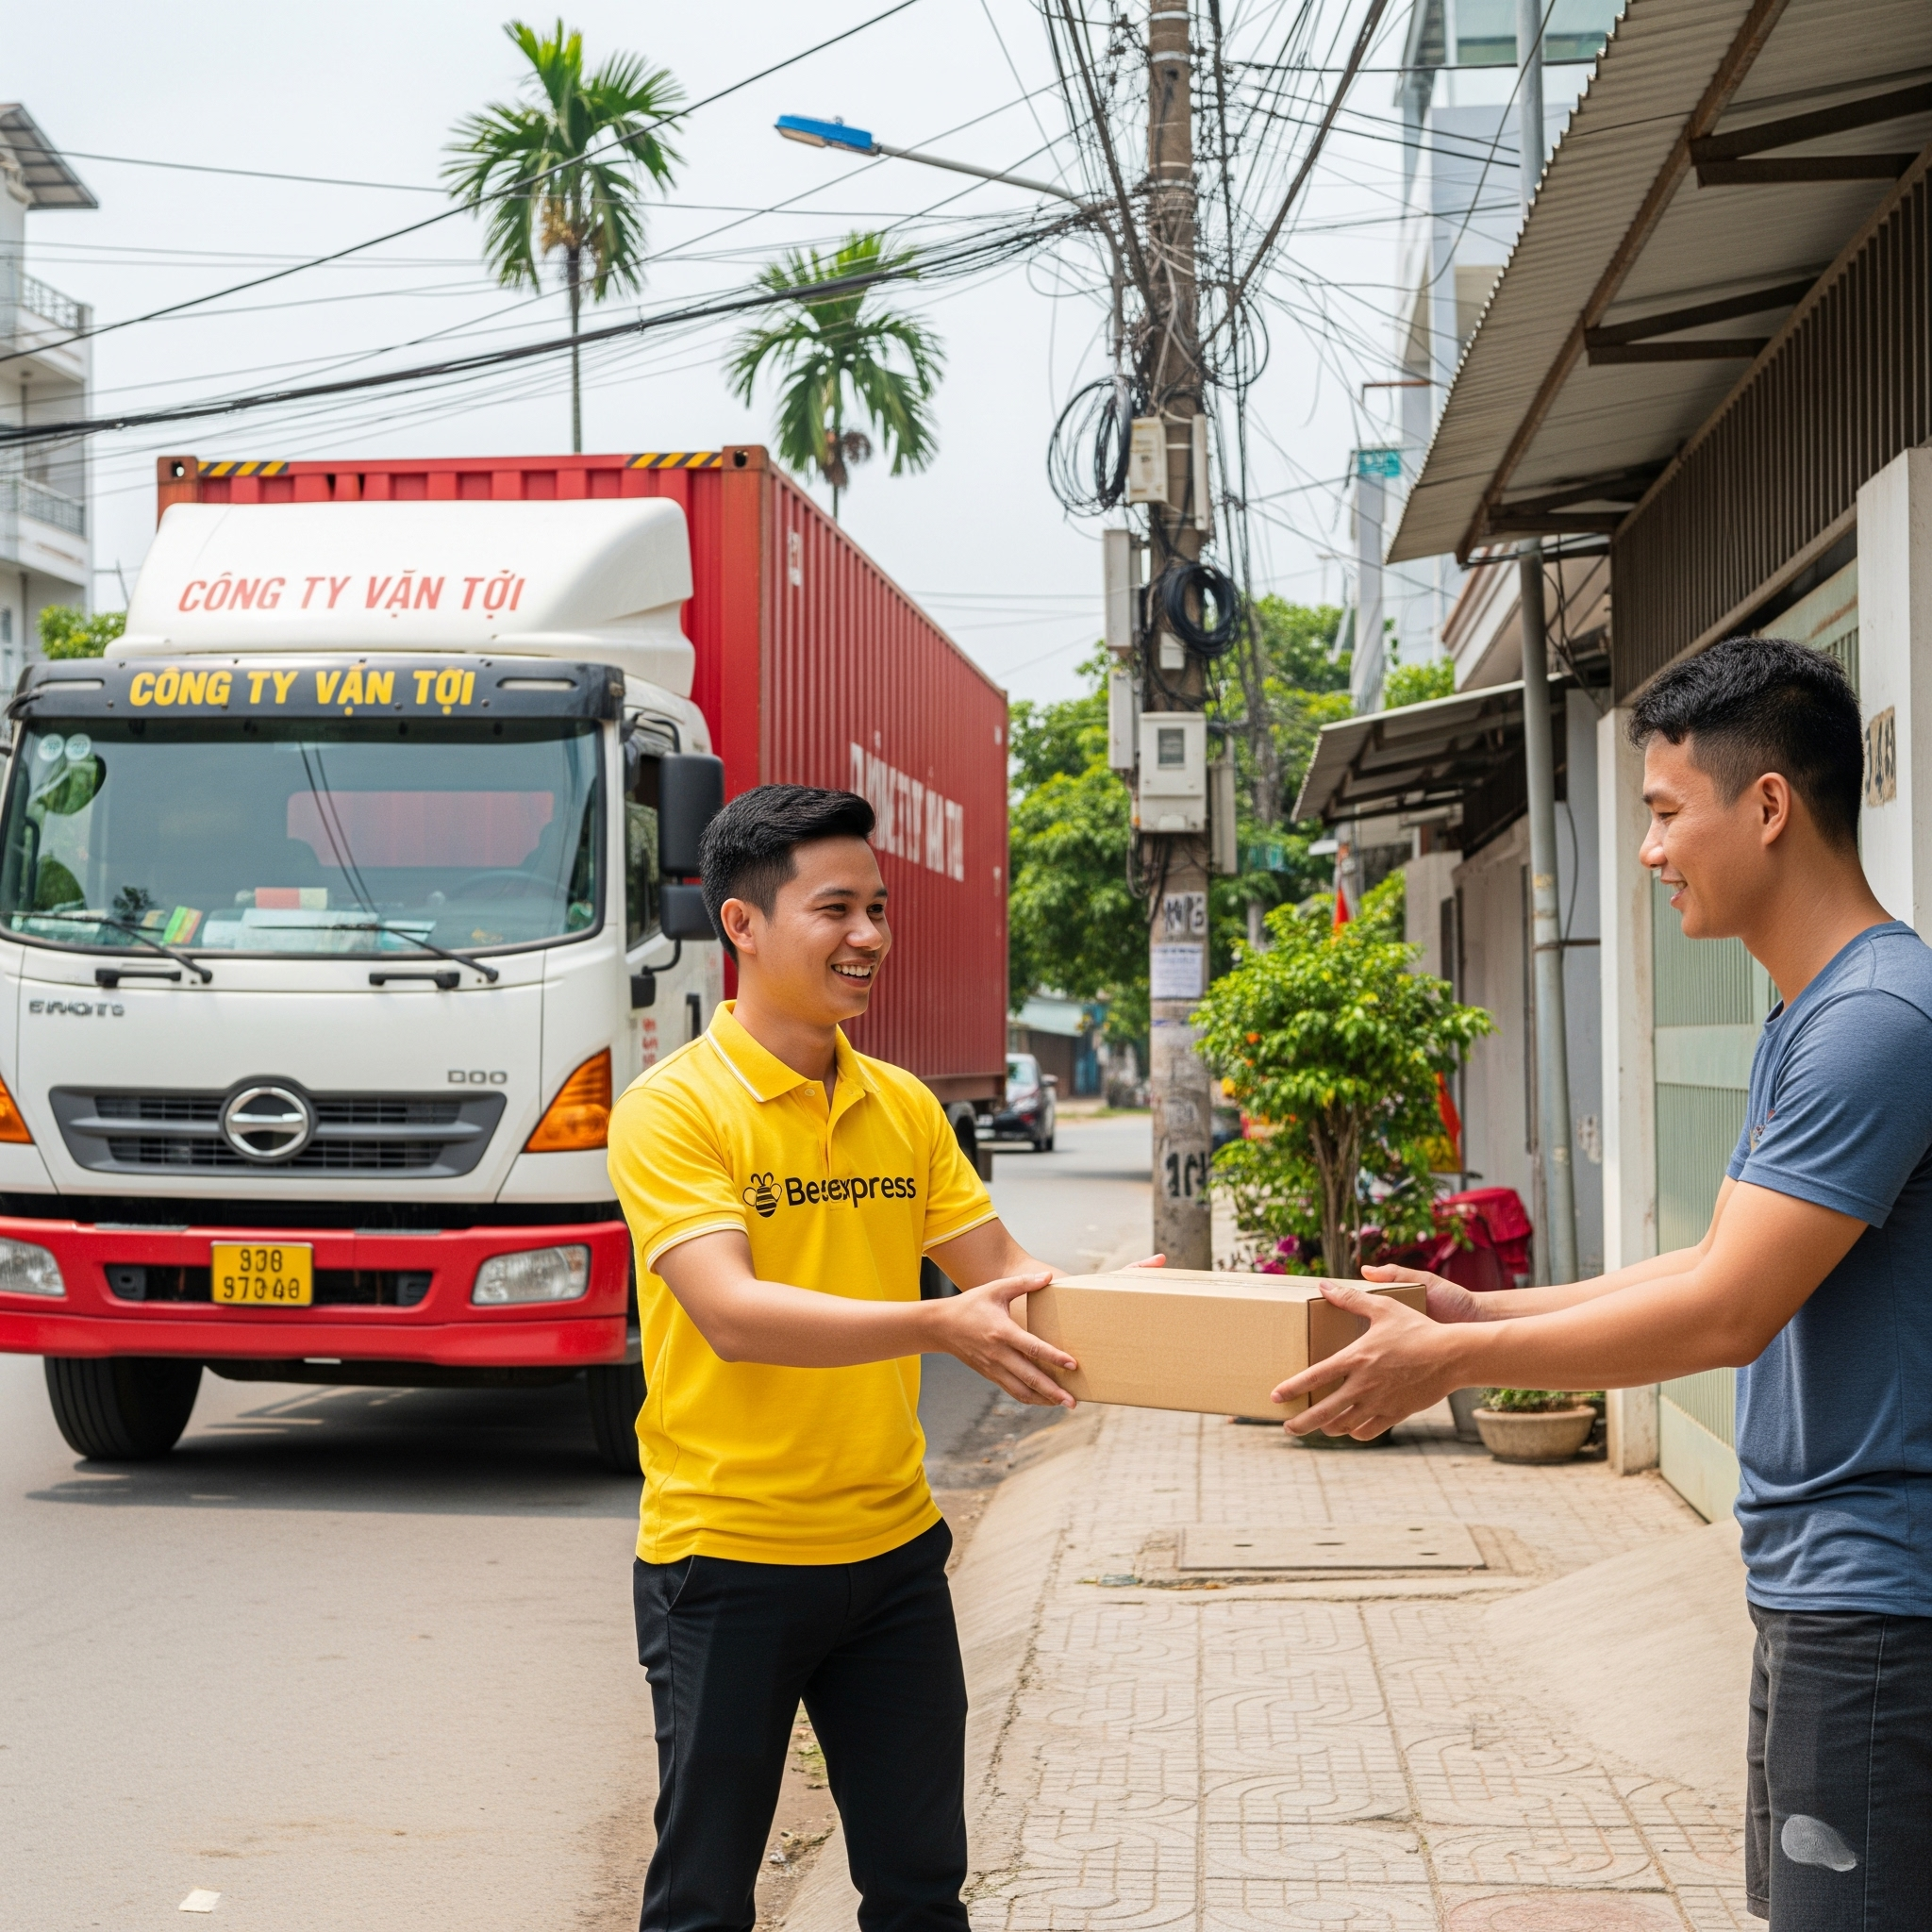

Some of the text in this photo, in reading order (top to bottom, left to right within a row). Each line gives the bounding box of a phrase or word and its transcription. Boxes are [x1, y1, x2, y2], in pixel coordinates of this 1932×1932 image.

[178, 573, 286, 612] CÔNG
[301, 576, 352, 609] TY
[129, 667, 233, 707] CÔNG
[247, 671, 299, 705] TY
